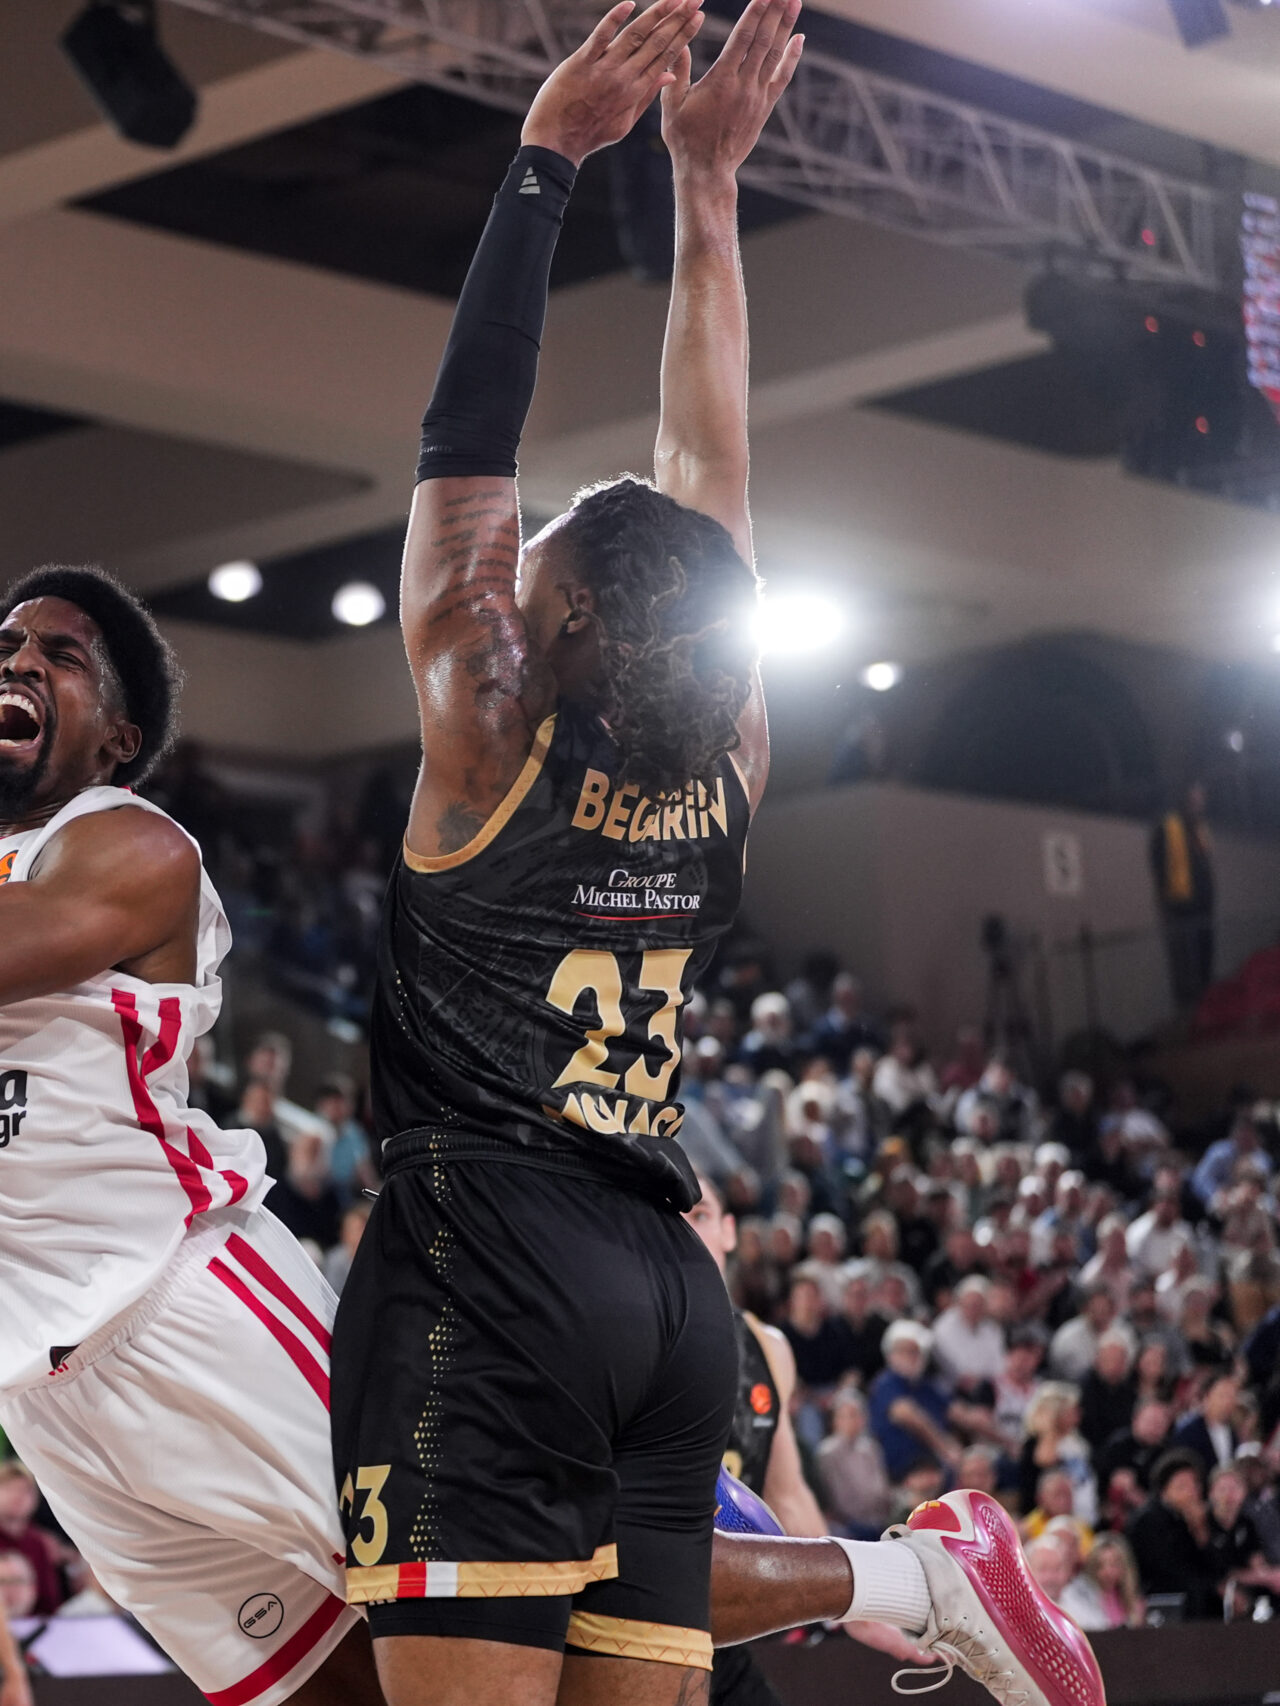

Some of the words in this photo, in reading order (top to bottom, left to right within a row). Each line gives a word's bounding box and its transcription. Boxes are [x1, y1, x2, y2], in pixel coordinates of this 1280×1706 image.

[608, 869, 677, 888] GROUPE
[571, 884, 642, 909] MICHEL
[644, 888, 700, 910] PASTOR
[546, 948, 693, 1102] 23
